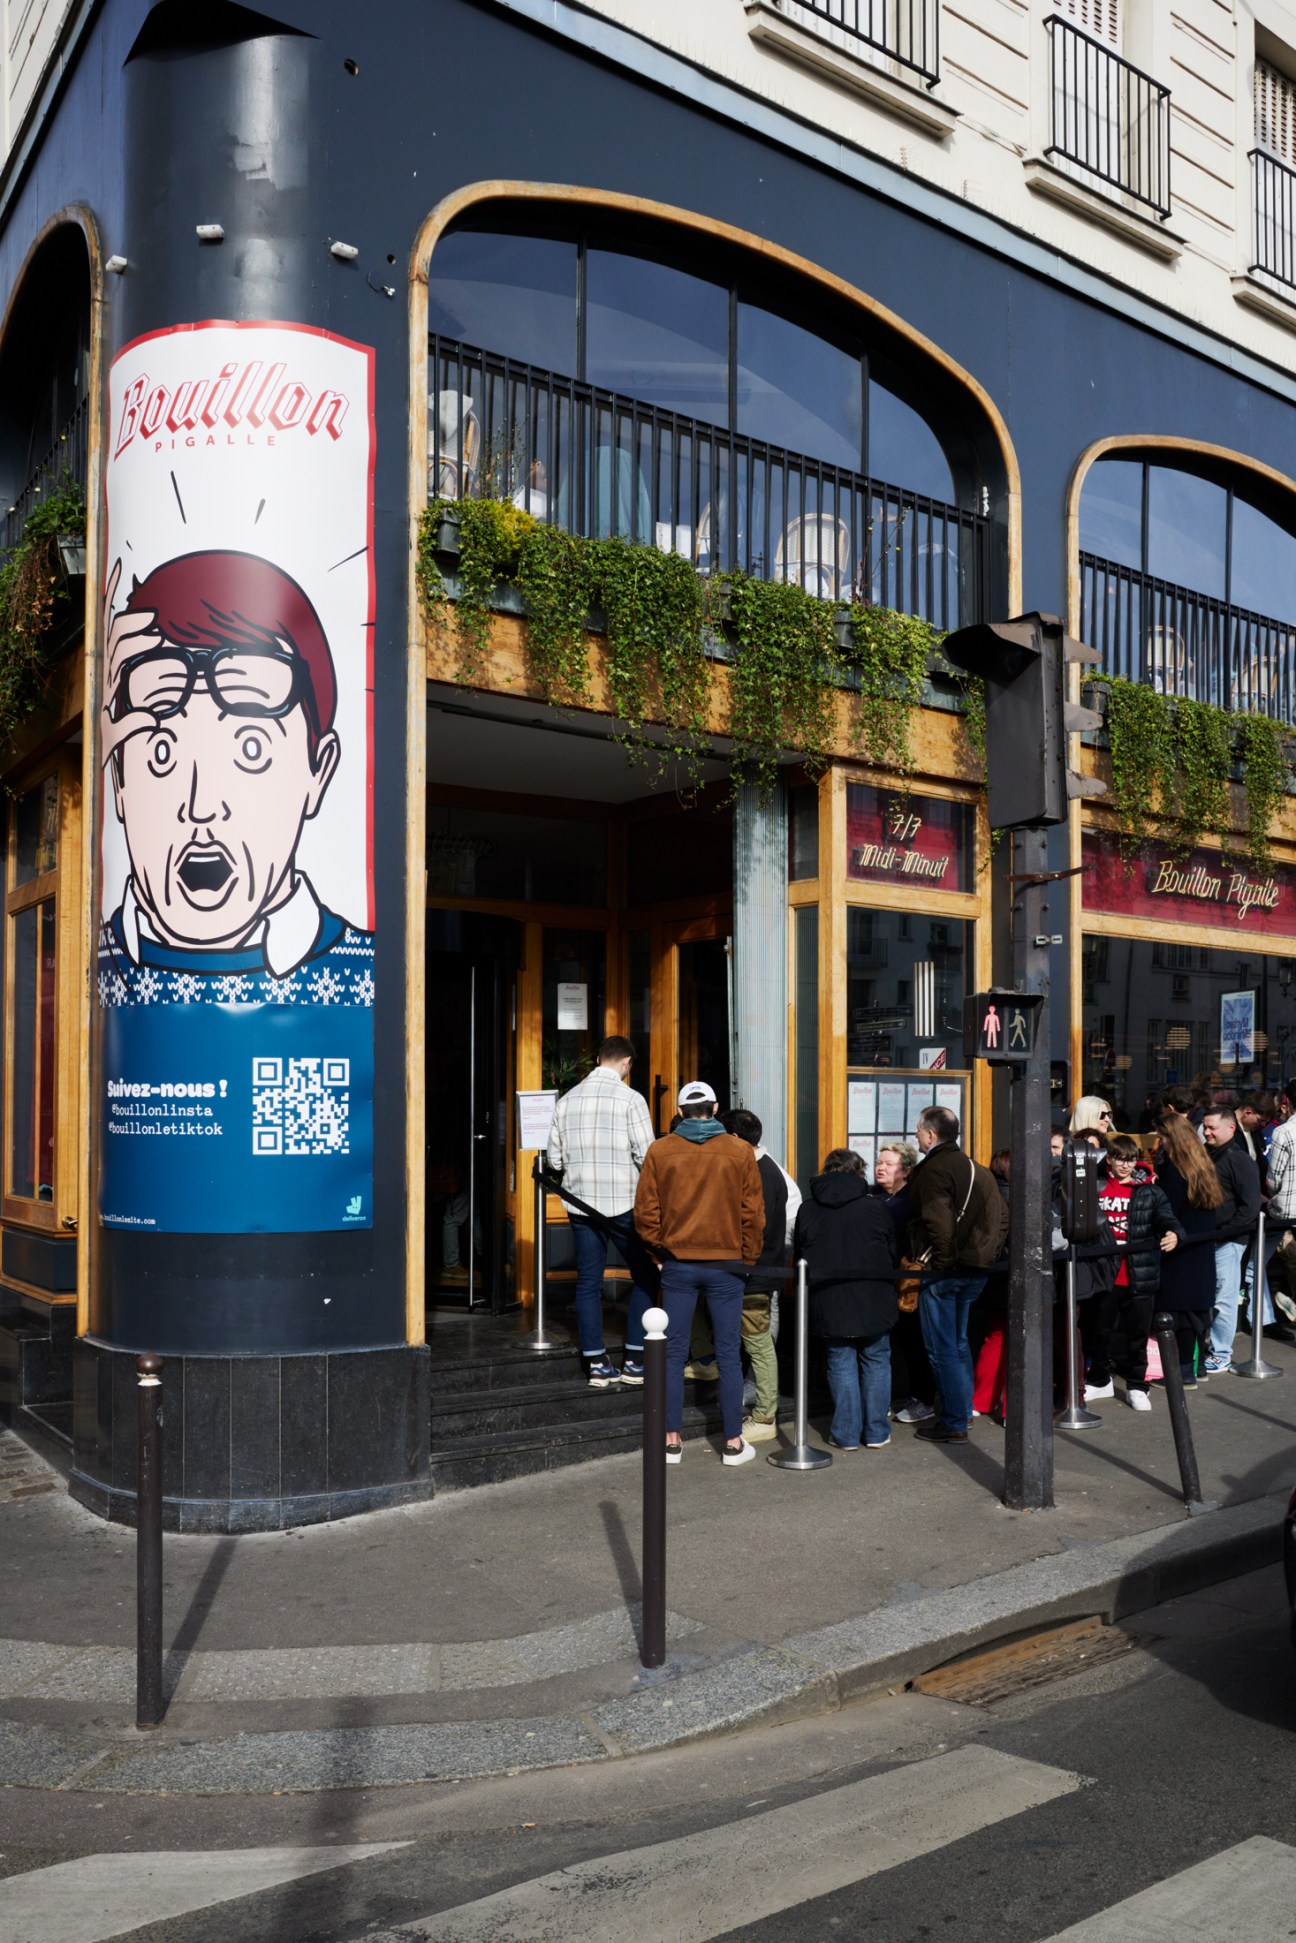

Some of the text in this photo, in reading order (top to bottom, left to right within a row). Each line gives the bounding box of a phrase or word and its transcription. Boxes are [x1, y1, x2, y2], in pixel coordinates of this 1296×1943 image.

[113, 360, 350, 462] Bouillon
[155, 434, 276, 452] PIGALLE
[892, 813, 922, 841] 7/7
[859, 843, 949, 878] Midi-Minuit
[1151, 860, 1280, 920] Bouillon Pigalle
[107, 1077, 216, 1098] Suivez-nous
[111, 1103, 214, 1117] @bouillonlinsta
[108, 1121, 223, 1136] @bouillonletiktok
